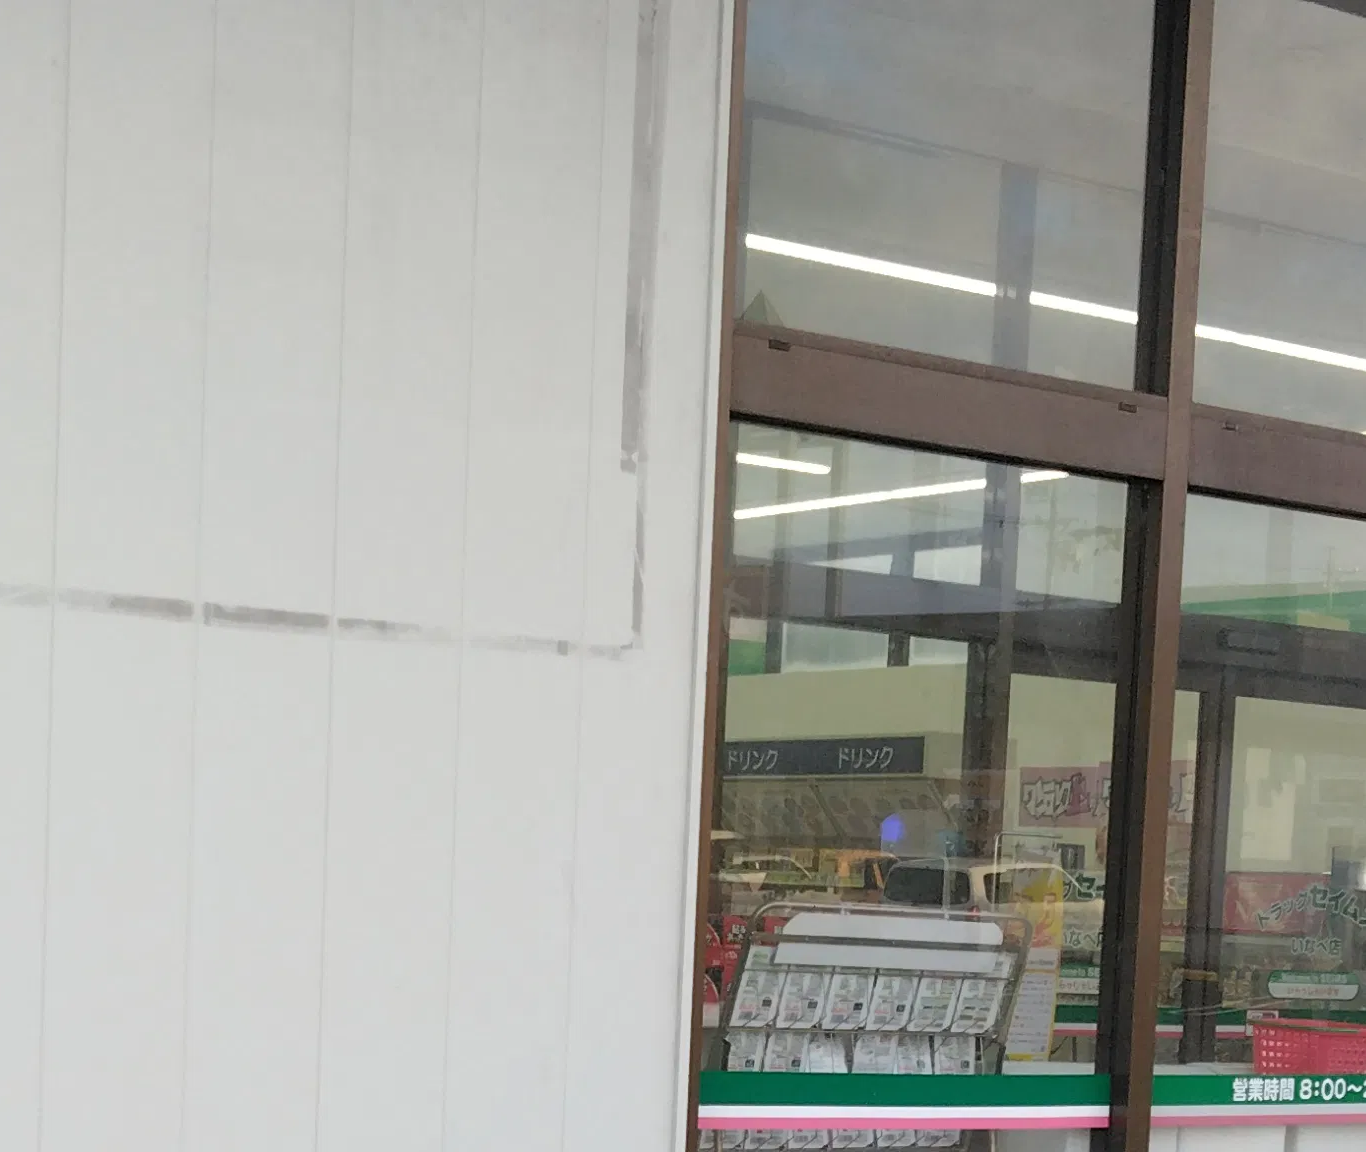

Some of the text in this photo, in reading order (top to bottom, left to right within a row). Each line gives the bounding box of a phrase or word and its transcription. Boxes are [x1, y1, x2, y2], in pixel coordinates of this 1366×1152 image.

[727, 749, 779, 771] ドリンク
[838, 746, 894, 769] ドリンク
[1232, 1077, 1295, 1101] 営業時間
